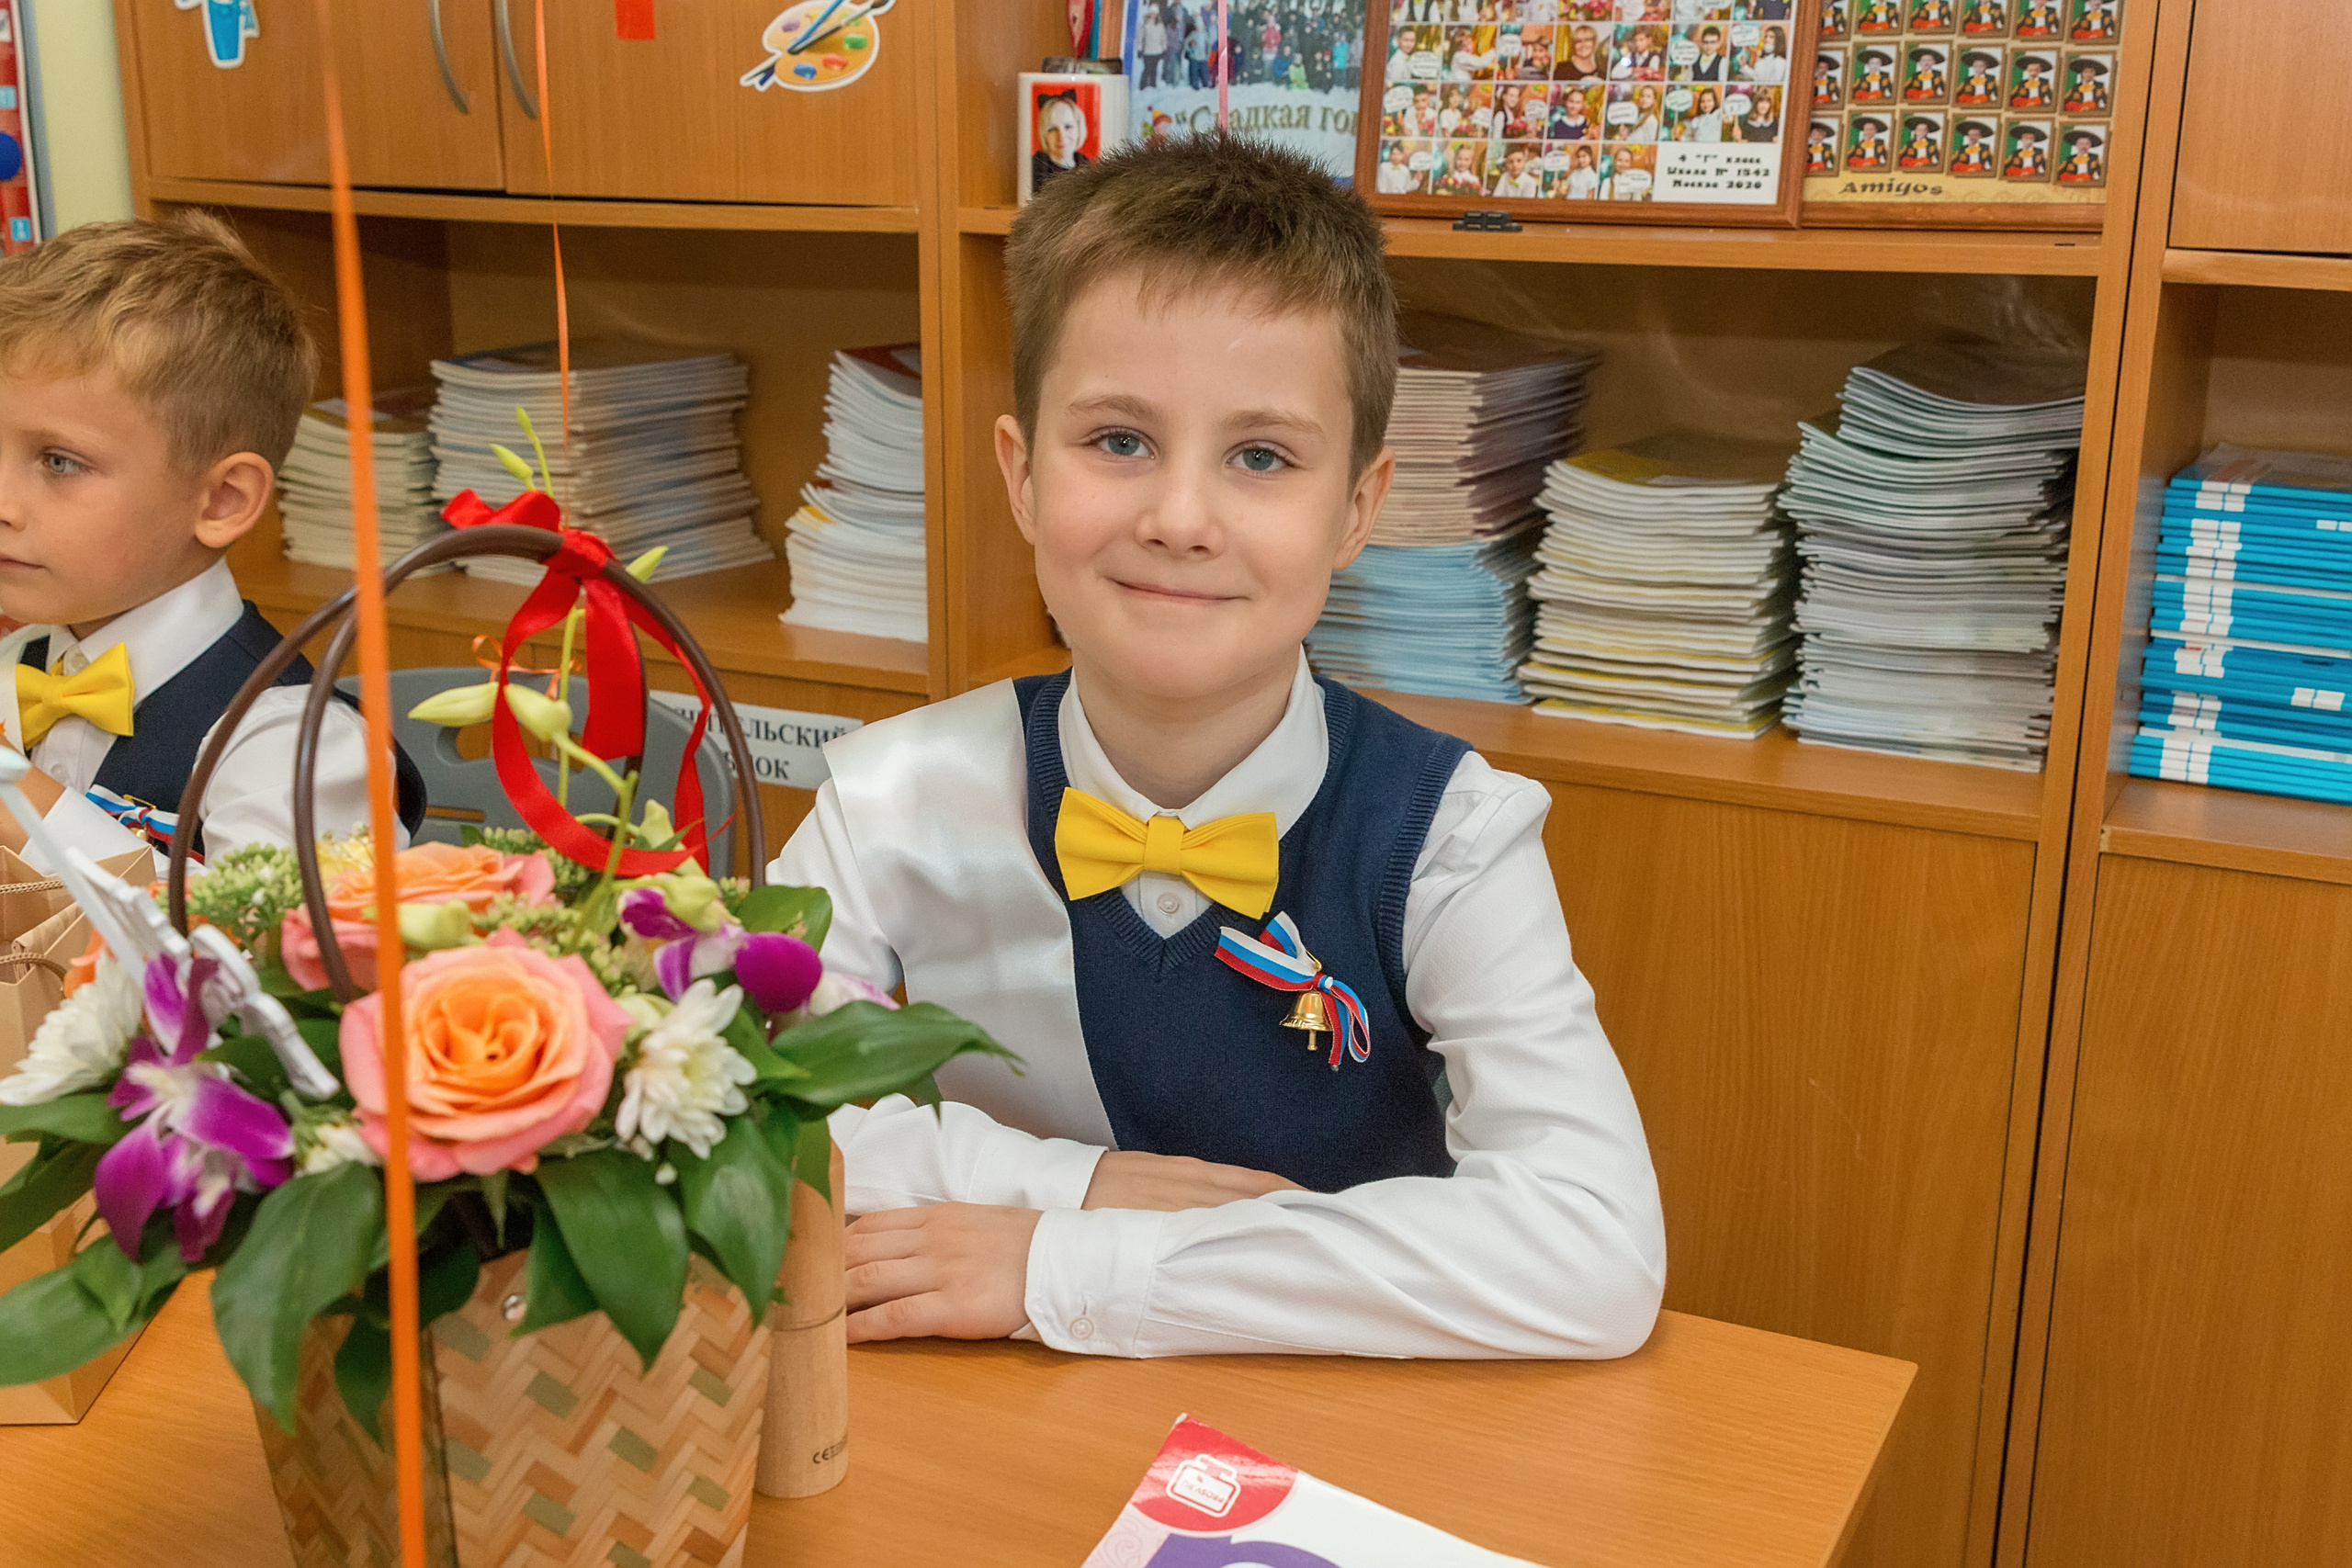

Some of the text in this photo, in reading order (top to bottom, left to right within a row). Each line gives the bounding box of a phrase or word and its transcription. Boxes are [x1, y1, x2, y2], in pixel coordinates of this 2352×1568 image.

[1667, 166, 1707, 175] Школа
[1672, 179, 1762, 189] Москва 2020
[1838, 177, 1943, 197] Amigos
